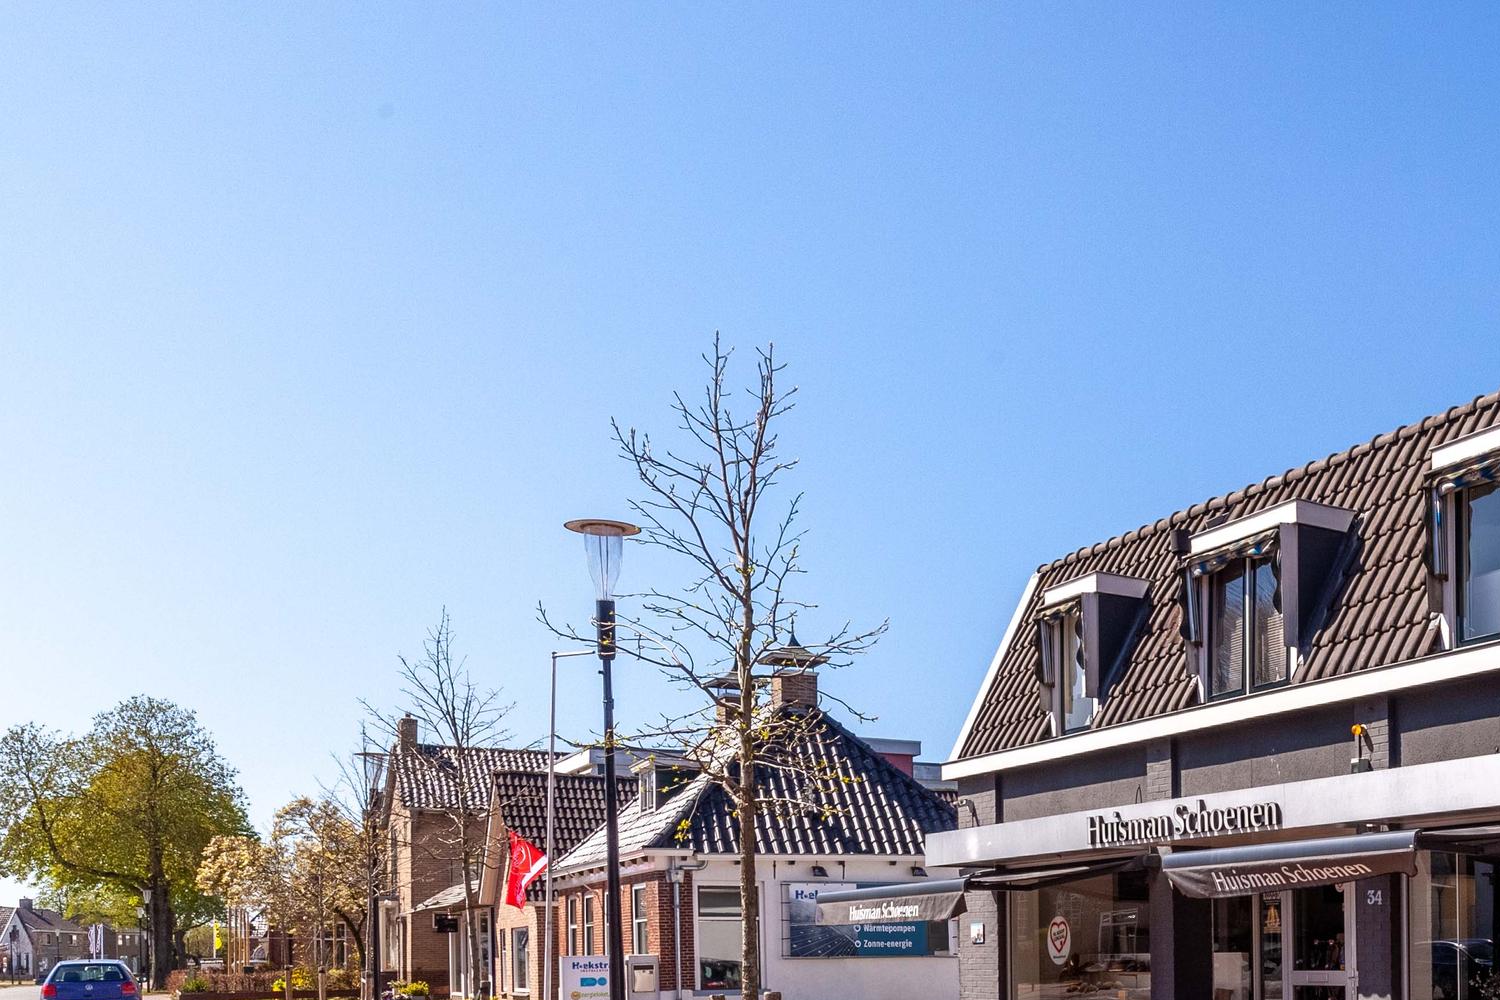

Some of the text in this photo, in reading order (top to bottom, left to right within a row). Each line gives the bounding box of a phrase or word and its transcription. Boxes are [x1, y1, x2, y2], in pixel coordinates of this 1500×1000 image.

[1087, 799, 1278, 845] Huisman Schoenen
[1211, 862, 1372, 892] Huisman Schoenen
[1366, 890, 1383, 905] 34
[849, 901, 919, 921] Huisman Schoenen
[864, 925, 916, 934] Warmtepompen
[864, 939, 913, 949] Zonne-energie
